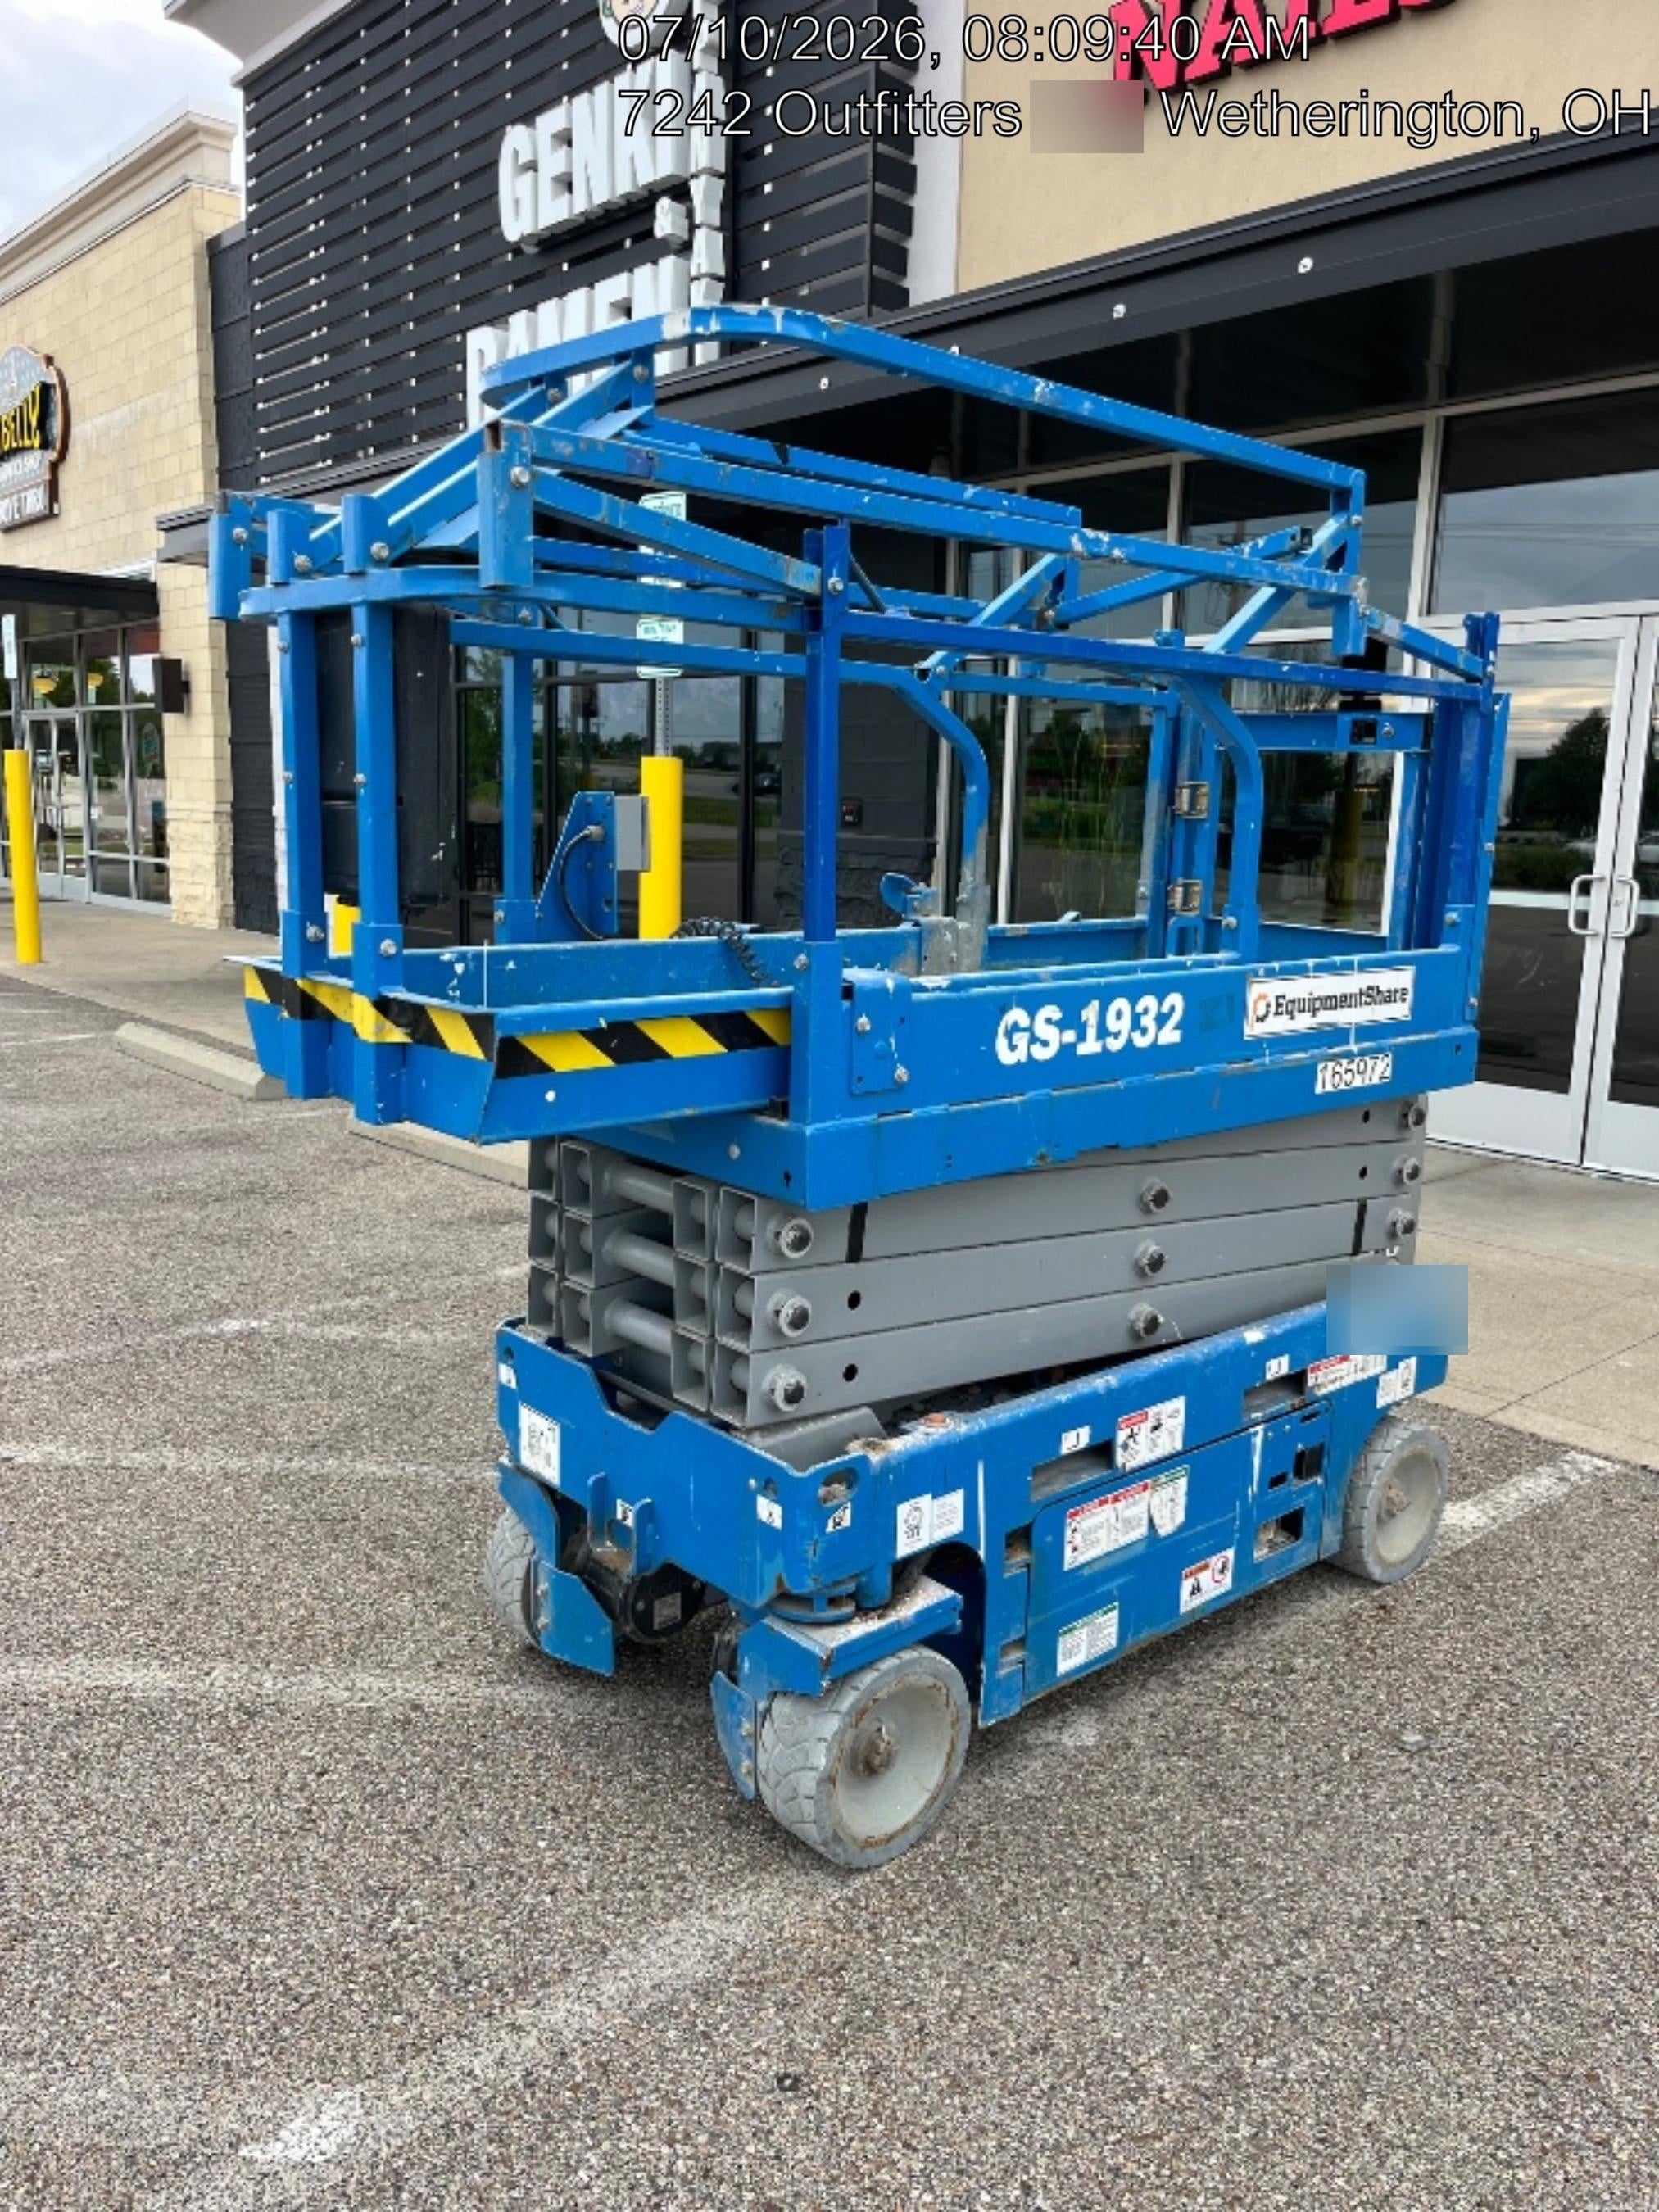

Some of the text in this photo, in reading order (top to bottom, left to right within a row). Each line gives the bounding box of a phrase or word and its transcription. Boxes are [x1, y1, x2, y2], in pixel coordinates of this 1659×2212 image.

[499, 49, 690, 243] GENKI
[995, 991, 1185, 1065] GS-1932
[1272, 984, 1409, 1021] EquipmentShare
[1319, 1054, 1390, 1090] 165972
